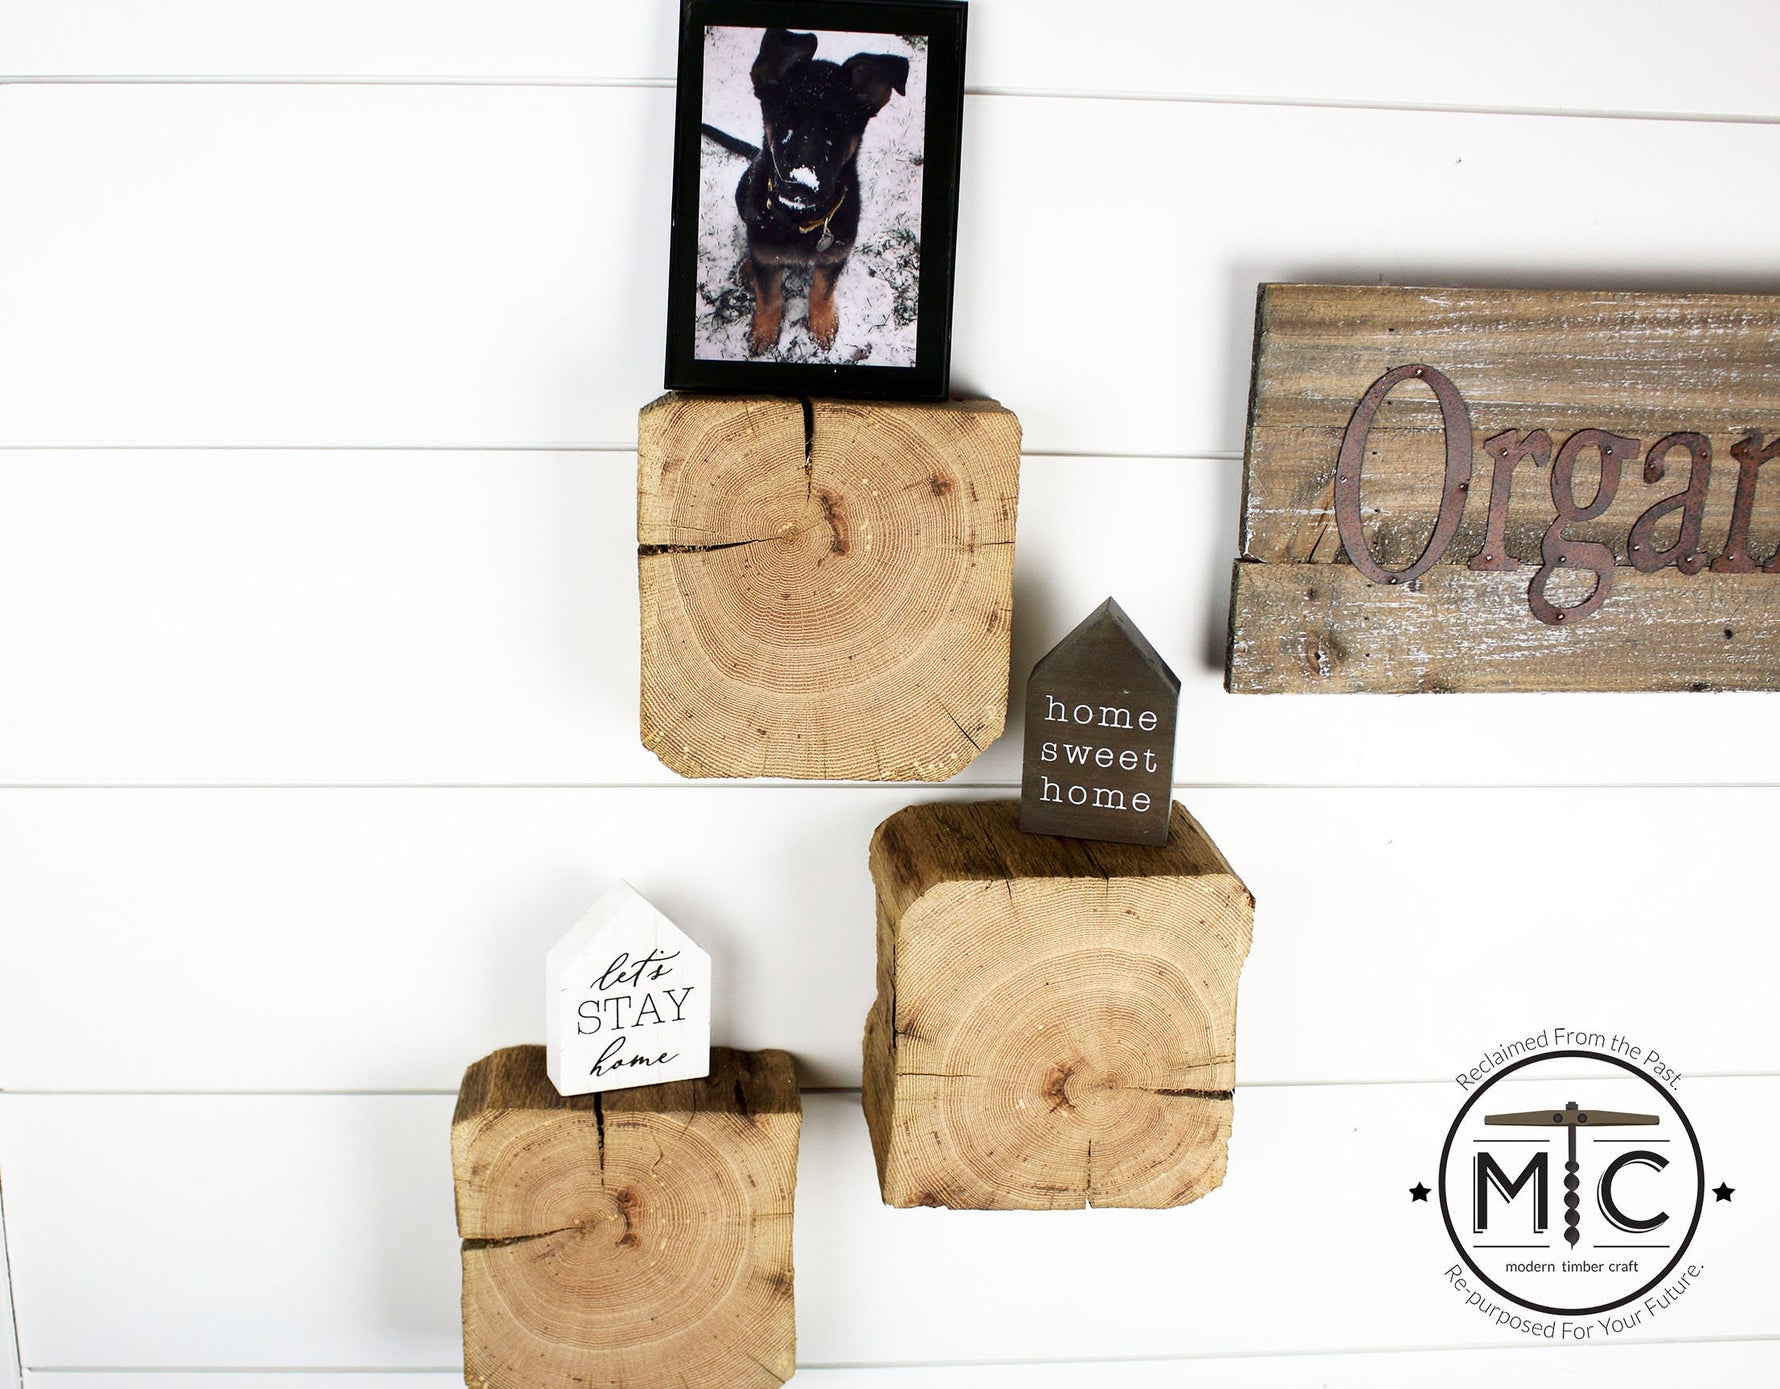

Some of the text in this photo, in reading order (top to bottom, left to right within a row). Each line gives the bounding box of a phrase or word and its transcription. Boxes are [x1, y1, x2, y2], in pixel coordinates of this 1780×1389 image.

[1044, 694, 1158, 732] home
[1040, 741, 1158, 773] sweet
[1039, 776, 1151, 812] home
[590, 948, 681, 991] let's
[577, 986, 695, 1035] STAY
[589, 1036, 680, 1077] home
